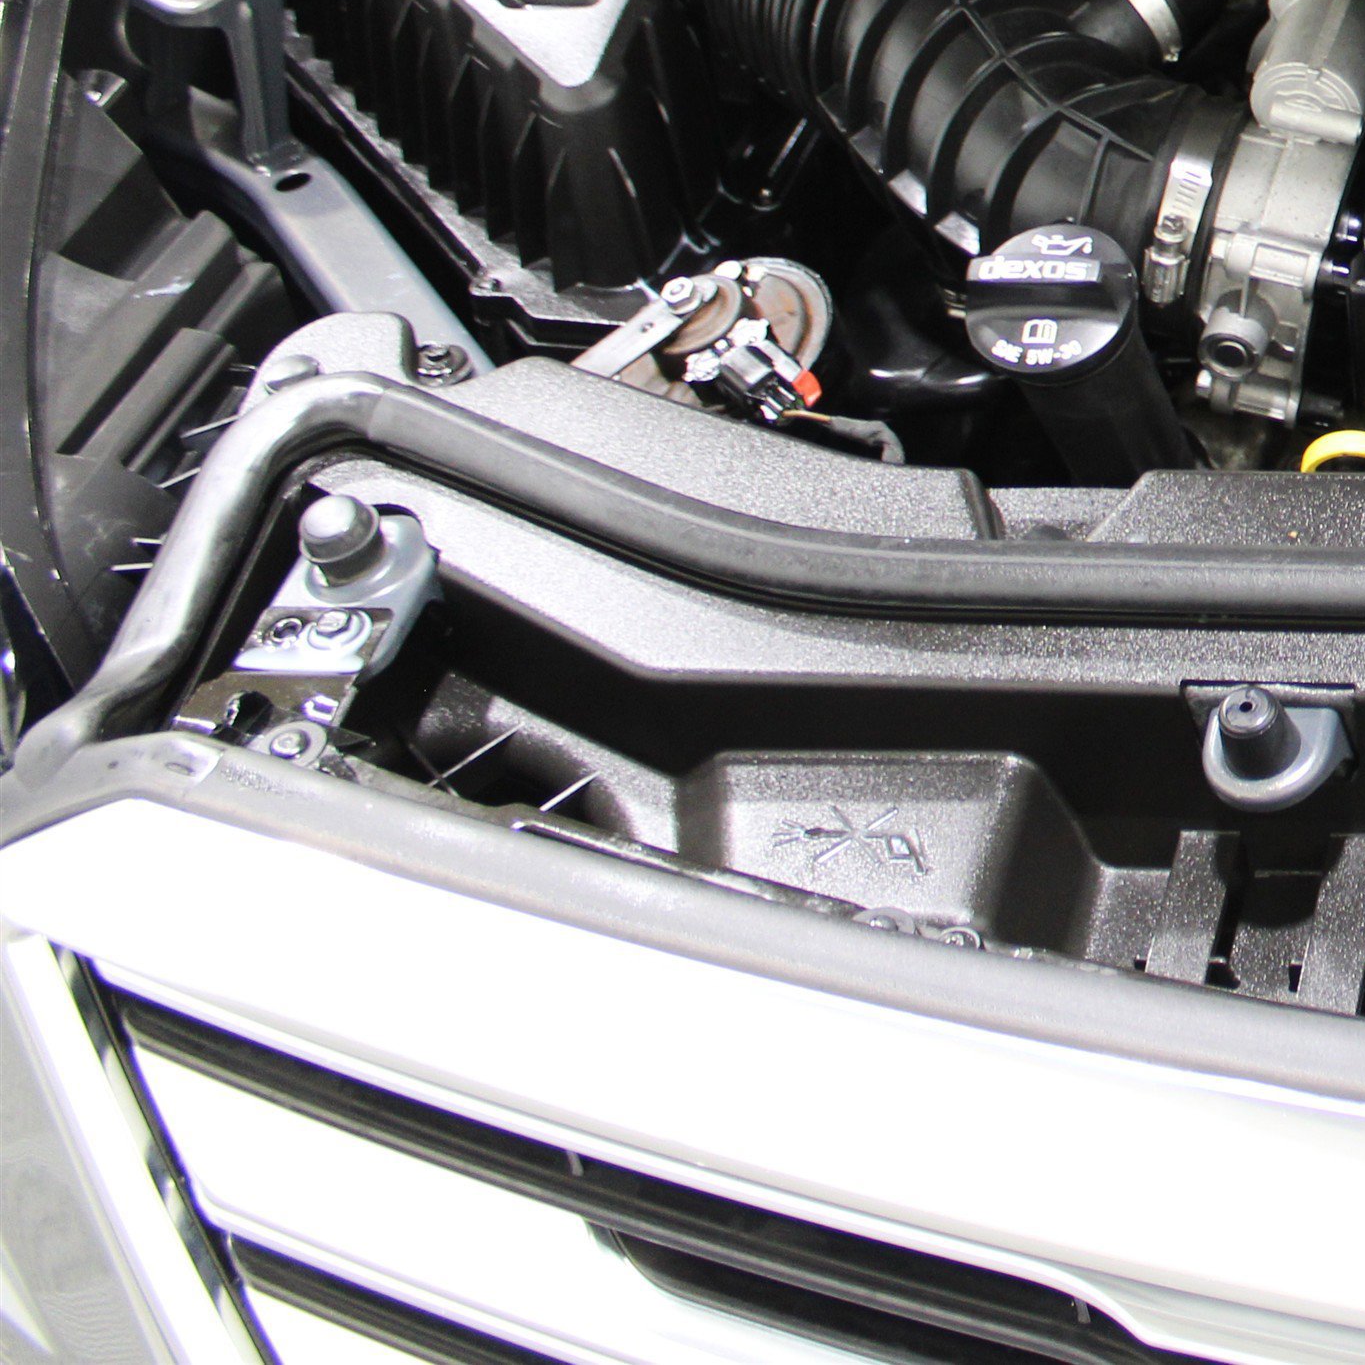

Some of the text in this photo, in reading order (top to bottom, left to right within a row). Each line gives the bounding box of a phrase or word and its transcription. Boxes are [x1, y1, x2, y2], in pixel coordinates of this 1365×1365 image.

[978, 255, 1088, 281] dexos
[991, 339, 1082, 366] SAE 5W-30
